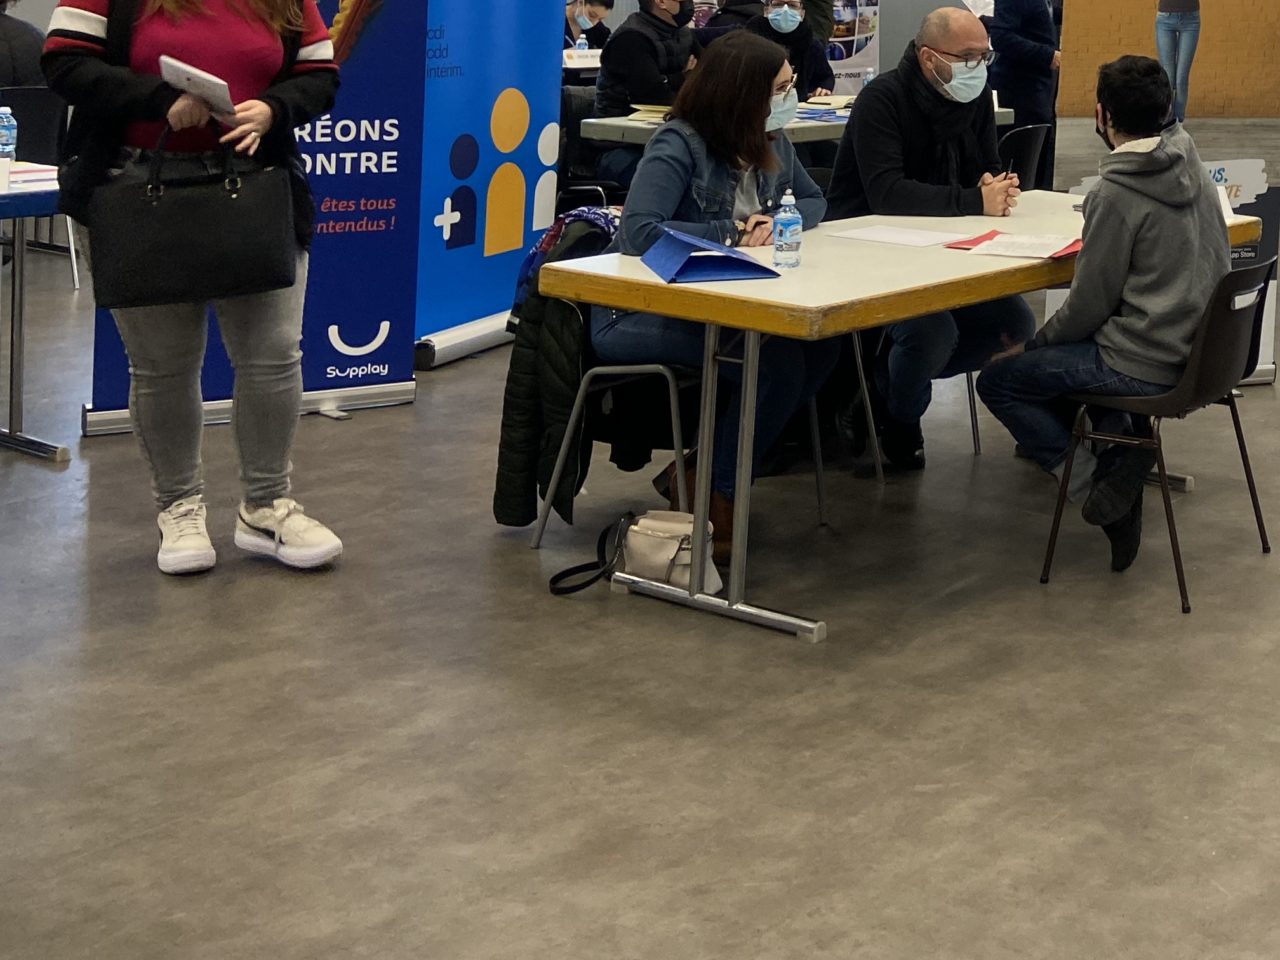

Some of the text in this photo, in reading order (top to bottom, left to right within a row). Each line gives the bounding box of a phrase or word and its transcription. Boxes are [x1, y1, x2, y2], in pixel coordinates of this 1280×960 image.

[293, 114, 400, 142] RÉONS
[320, 197, 396, 212] êtes tous
[316, 216, 386, 234] ntendus
[325, 363, 389, 378] Supplay
